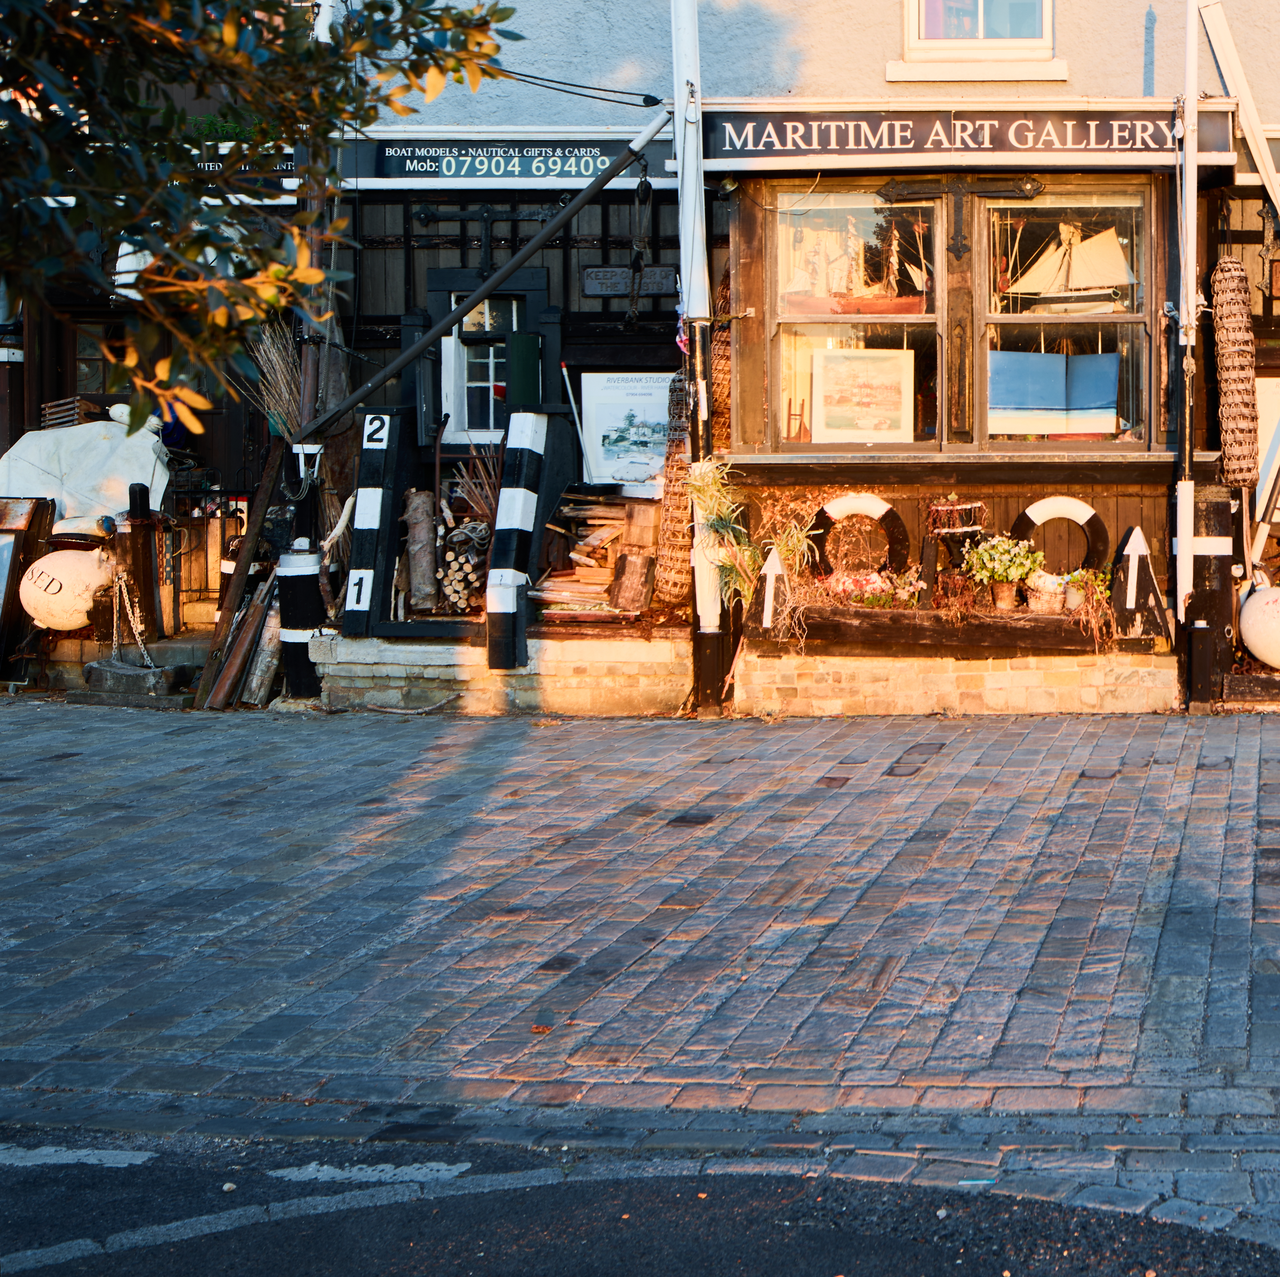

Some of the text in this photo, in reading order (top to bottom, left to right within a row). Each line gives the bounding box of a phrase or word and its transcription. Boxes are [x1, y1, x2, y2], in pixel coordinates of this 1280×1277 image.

[723, 118, 1177, 150] MARITIME ART GALLERY
[385, 147, 600, 157] BOAT MODELS NAUTICAL GIFTS & CARDS
[405, 157, 626, 176] Mob: 07904 69409
[586, 270, 617, 281] KEEP
[660, 269, 674, 280] OF
[598, 282, 620, 292] THE
[606, 376, 671, 384] RIVERBANK STUDIO
[366, 415, 386, 443] 2
[353, 576, 364, 605] 1
